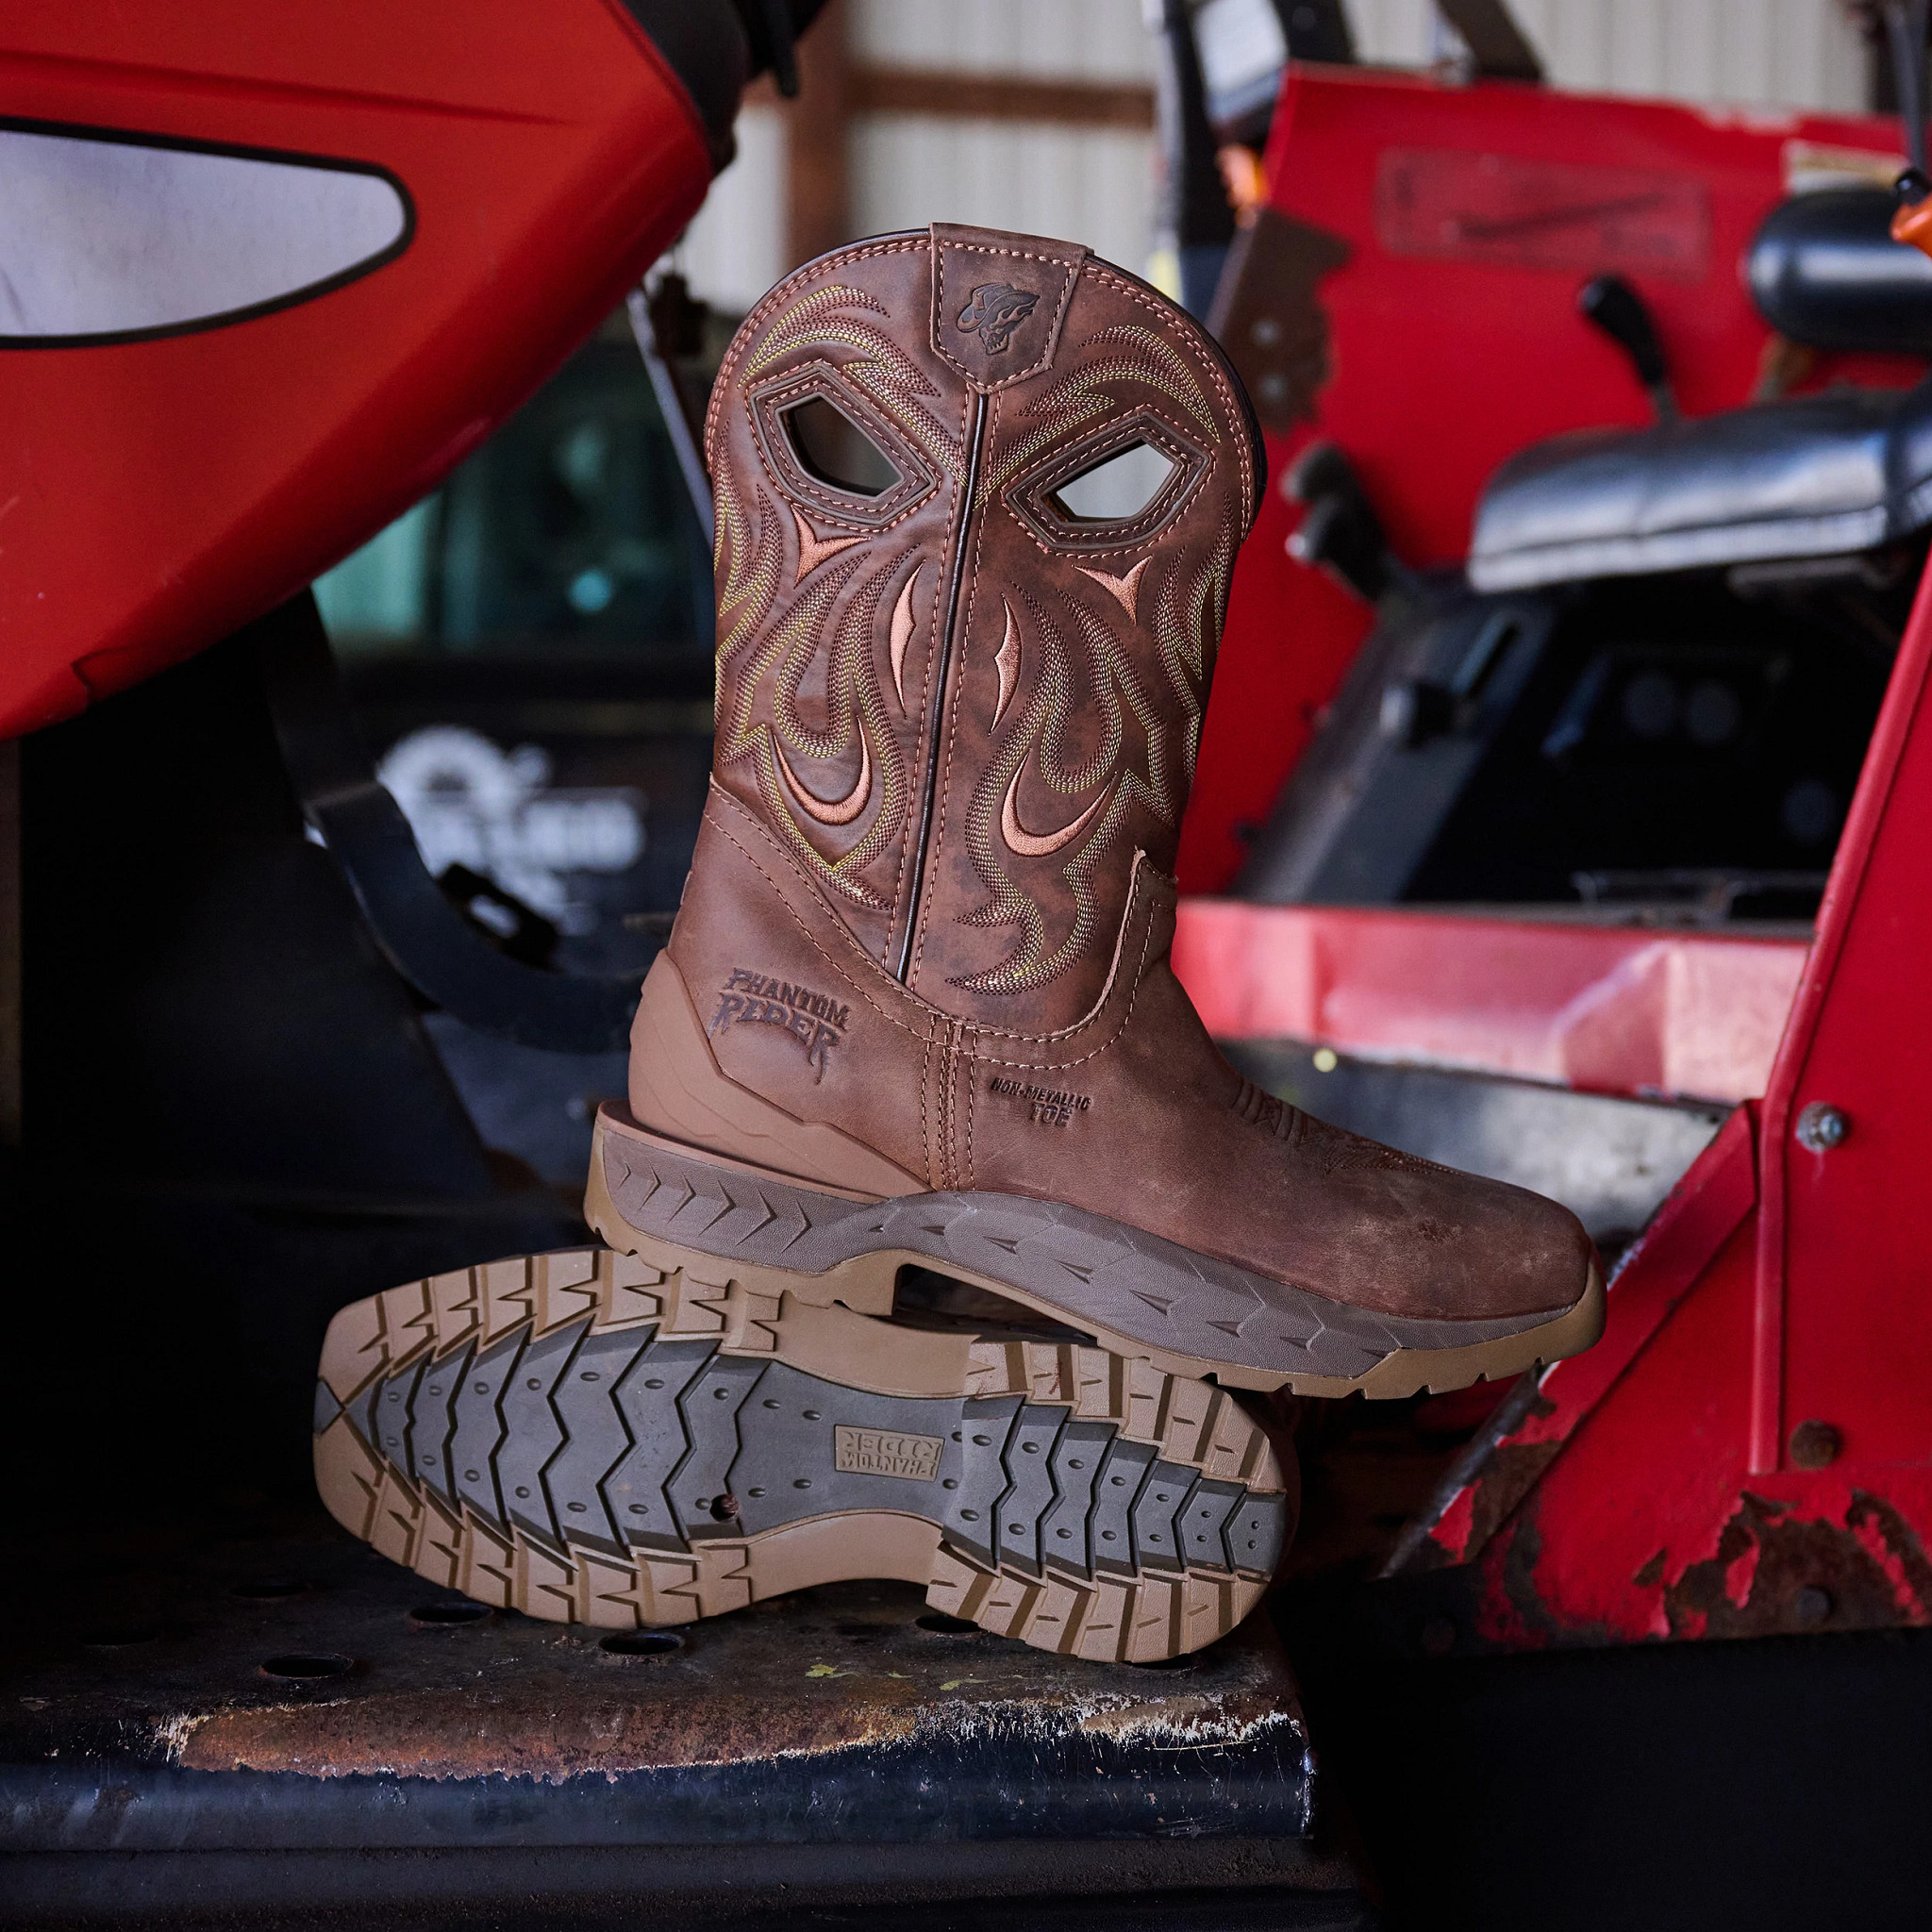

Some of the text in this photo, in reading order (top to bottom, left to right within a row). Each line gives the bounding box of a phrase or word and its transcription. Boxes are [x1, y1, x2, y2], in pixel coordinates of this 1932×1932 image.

[722, 967, 850, 1030] PHANTOM
[991, 1077, 1091, 1110] NON-METALLIC
[1030, 1104, 1073, 1127] TOE
[842, 1430, 941, 1461] RIDER
[841, 1451, 937, 1477] PHANTOM
